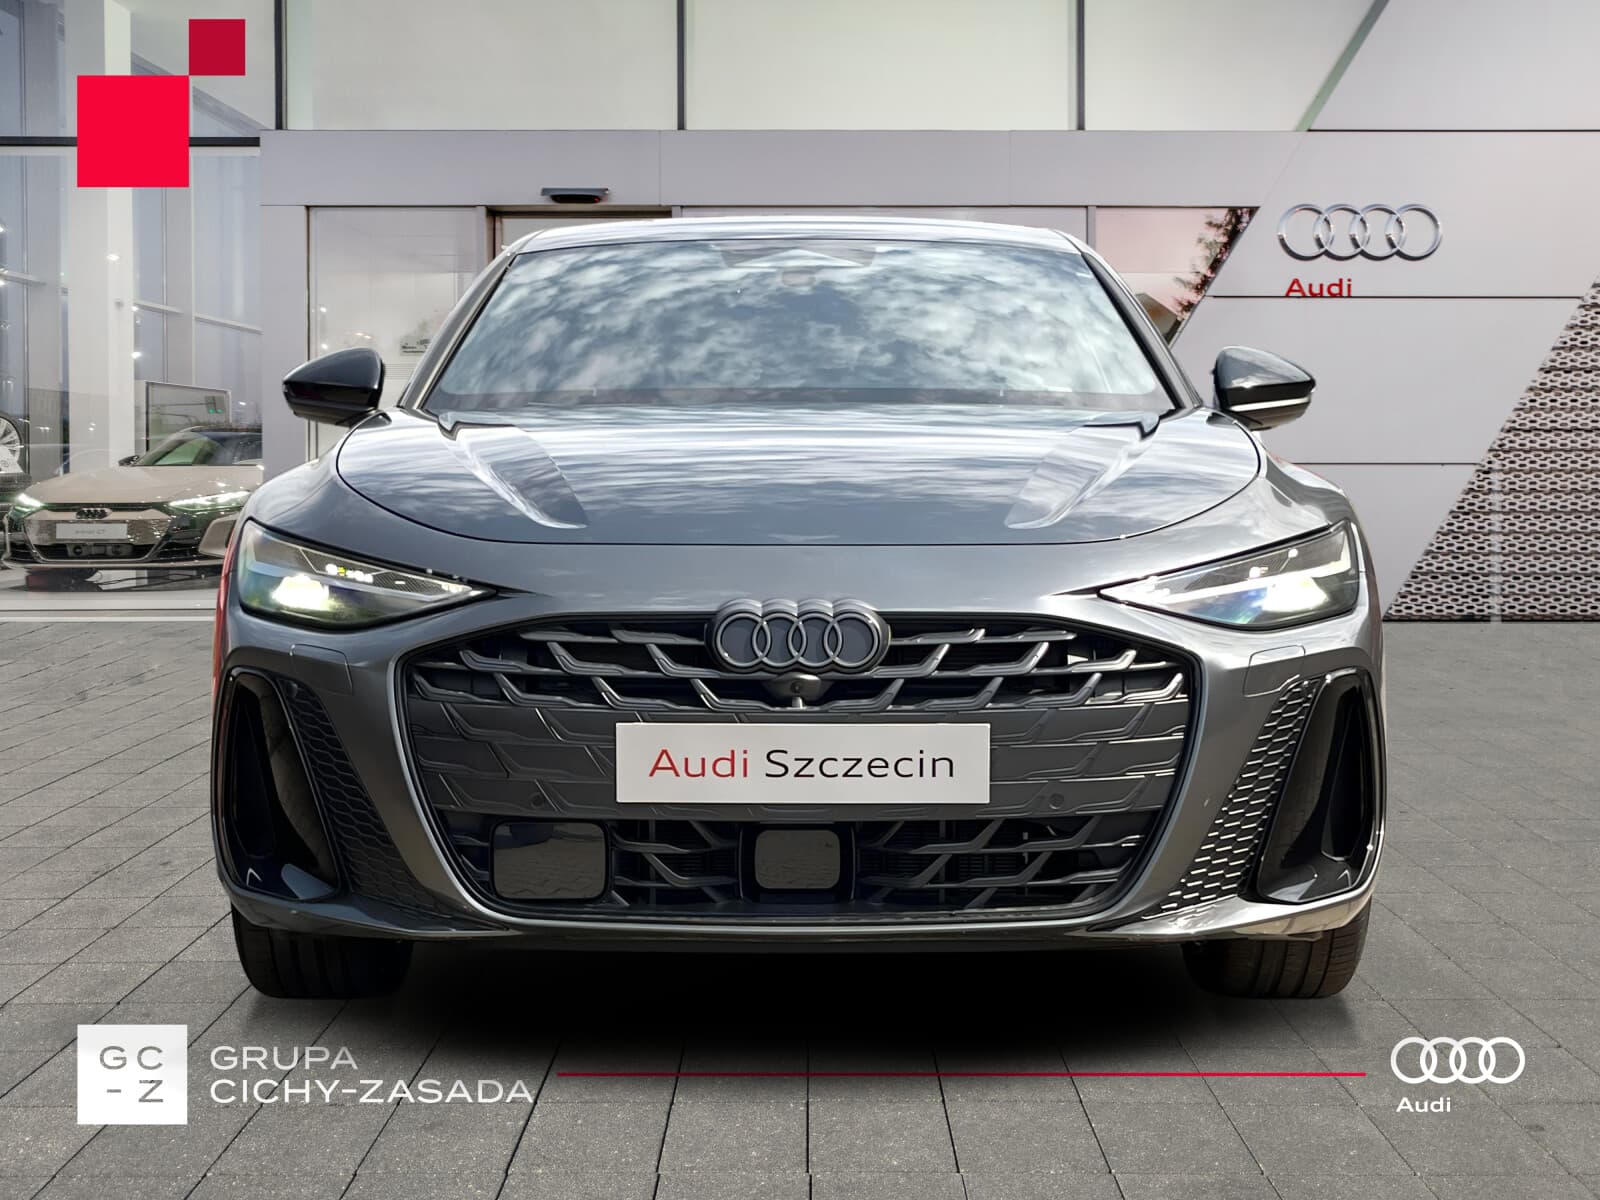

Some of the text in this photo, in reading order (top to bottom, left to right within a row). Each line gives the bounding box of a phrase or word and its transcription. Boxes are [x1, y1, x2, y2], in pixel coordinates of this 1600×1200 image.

[1285, 278, 1352, 297] Audi
[648, 749, 955, 778] Audi Szczecin
